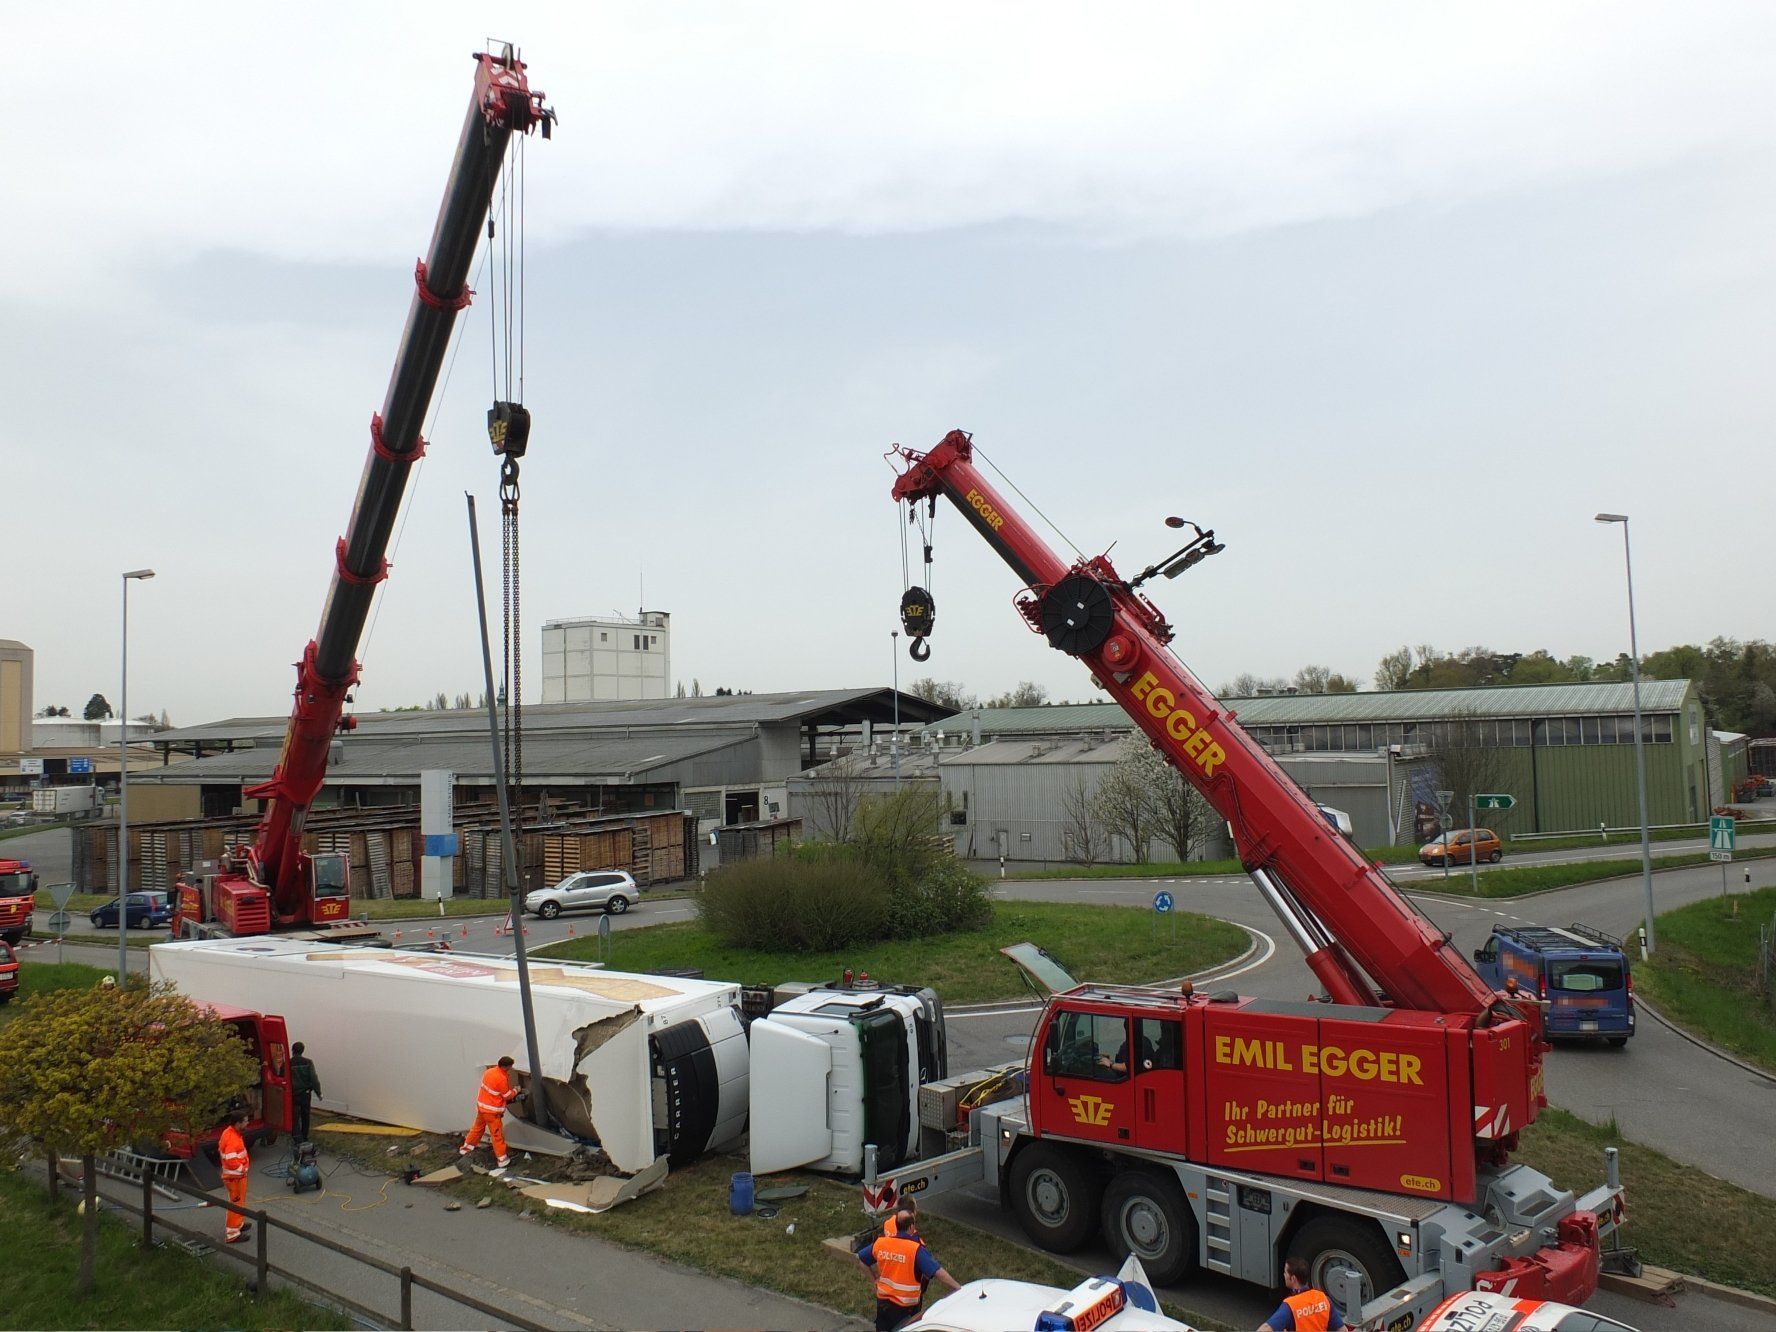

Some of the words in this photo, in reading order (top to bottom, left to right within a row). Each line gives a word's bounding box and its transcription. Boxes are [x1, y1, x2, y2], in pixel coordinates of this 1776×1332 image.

[966, 488, 1004, 532] EGGER
[1130, 670, 1226, 778] EGGER
[764, 795, 769, 805] 8
[1498, 1037, 1511, 1051] 301
[1215, 1035, 1293, 1071] EMIL
[1302, 1044, 1425, 1086] EGGER
[670, 1066, 681, 1140] CARRIER
[1224, 1100, 1249, 1121] Ihr
[1256, 1099, 1320, 1119] Partner
[1327, 1094, 1355, 1114] für
[1225, 1115, 1402, 1147] Schwergut-Logistik!
[1405, 1178, 1436, 1189] ete.ch
[877, 1249, 906, 1263] POLIZEI
[1296, 1301, 1328, 1319] POLIZEI
